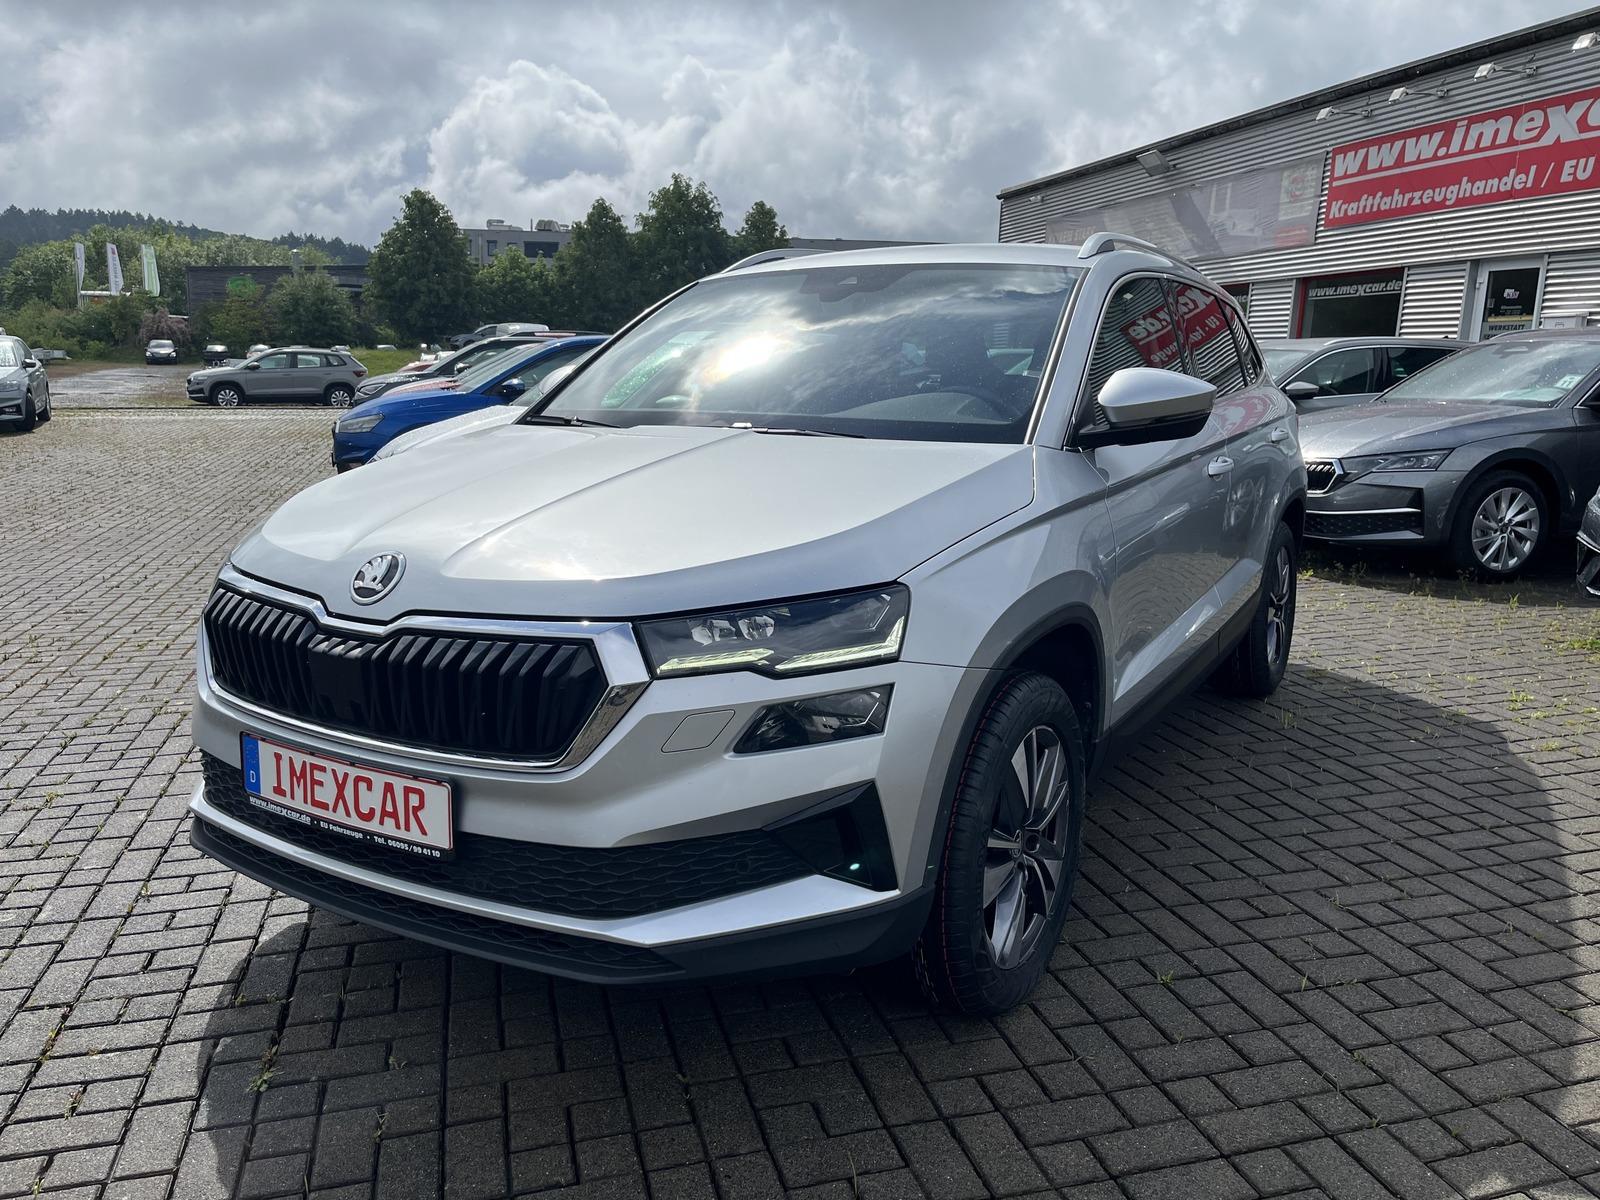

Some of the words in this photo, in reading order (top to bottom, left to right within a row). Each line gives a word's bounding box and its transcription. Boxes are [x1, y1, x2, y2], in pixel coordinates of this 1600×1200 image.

[1329, 165, 1537, 220] Kraftfahrzeughandel
[1560, 156, 1596, 183] EU
[250, 770, 256, 783] D
[272, 751, 428, 836] IMEXCAR
[320, 821, 328, 829] EU
[329, 823, 363, 838] Fahrzeuge
[374, 836, 386, 844] Tel.
